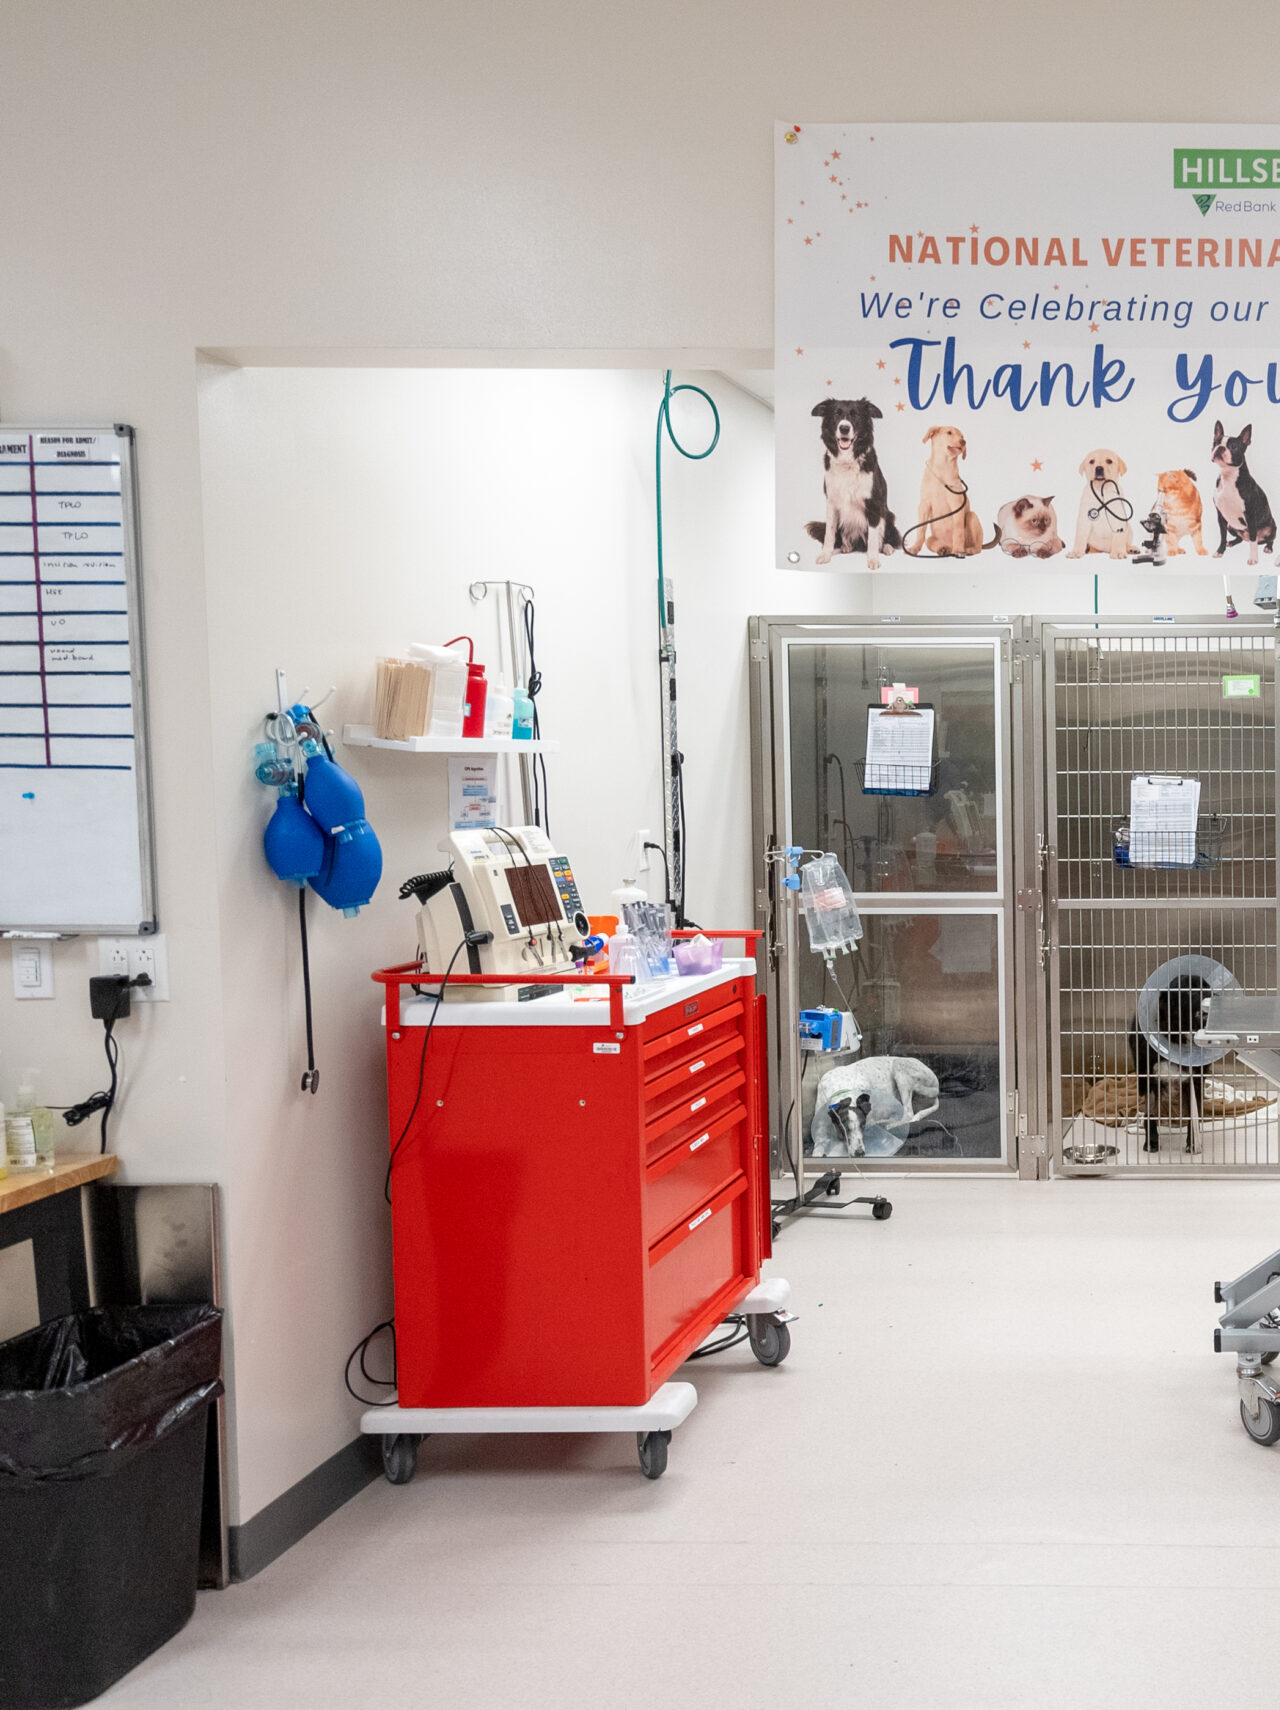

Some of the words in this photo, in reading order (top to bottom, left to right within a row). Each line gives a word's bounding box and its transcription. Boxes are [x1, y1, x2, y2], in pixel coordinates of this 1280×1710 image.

[888, 234, 1088, 266] NATIONAL
[860, 293, 961, 319] We're
[979, 294, 1193, 328] Celebrating
[1210, 302, 1269, 322] our
[889, 337, 1135, 412] Thank
